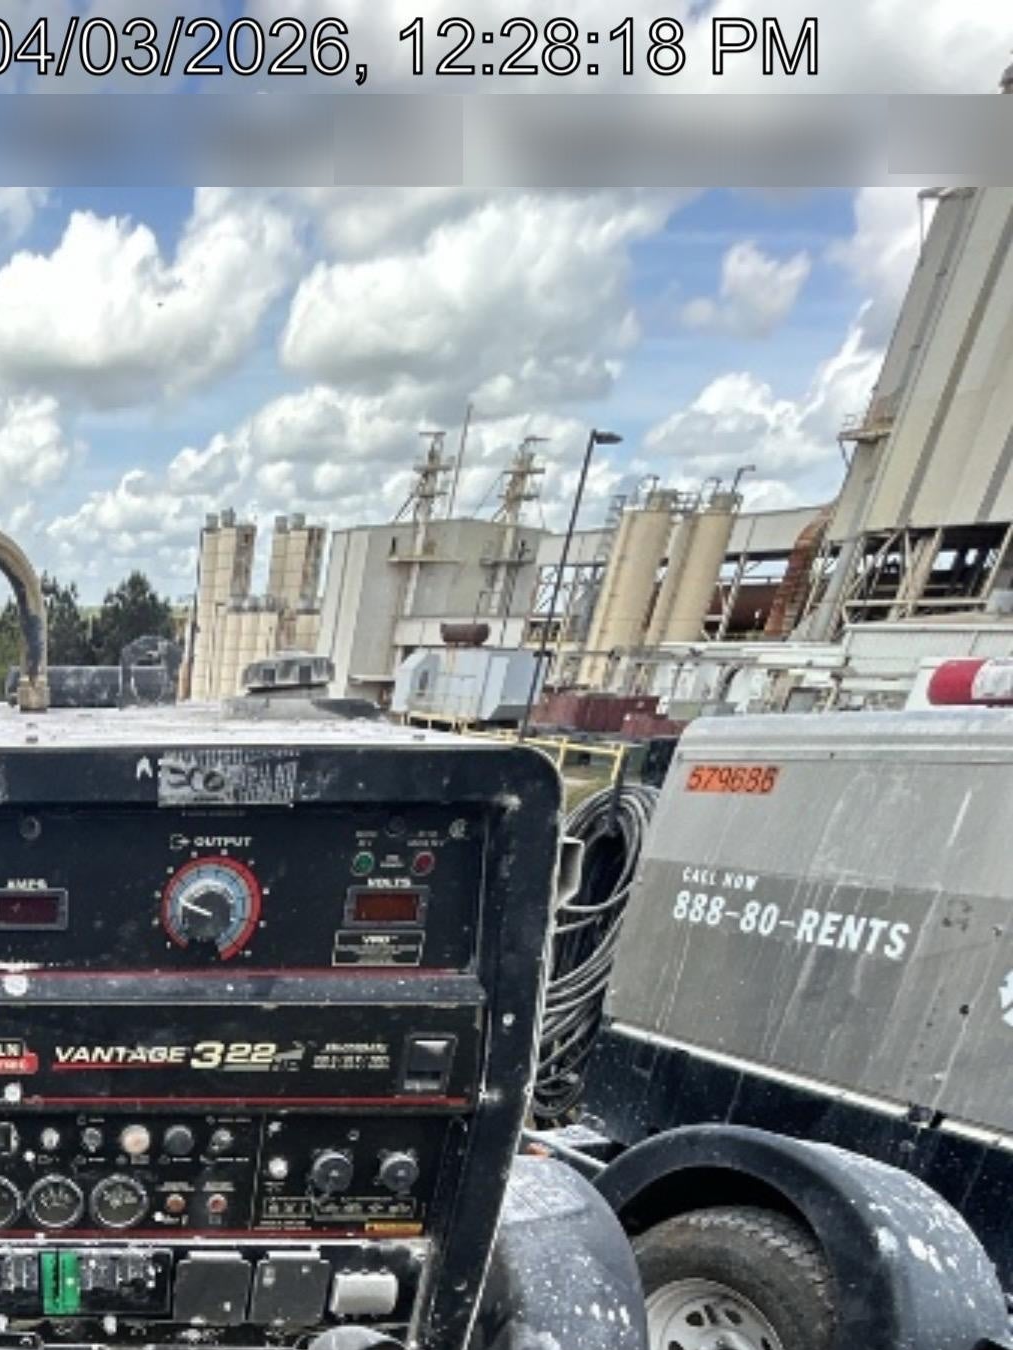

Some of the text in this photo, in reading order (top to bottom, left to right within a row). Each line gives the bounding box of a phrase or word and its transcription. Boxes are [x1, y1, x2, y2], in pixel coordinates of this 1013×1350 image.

[193, 836, 252, 848] OUTPUT
[682, 867, 759, 891] CALL NOW
[673, 890, 911, 961] 888-80-RENTS
[54, 1040, 277, 1070] VANTAGE 322
